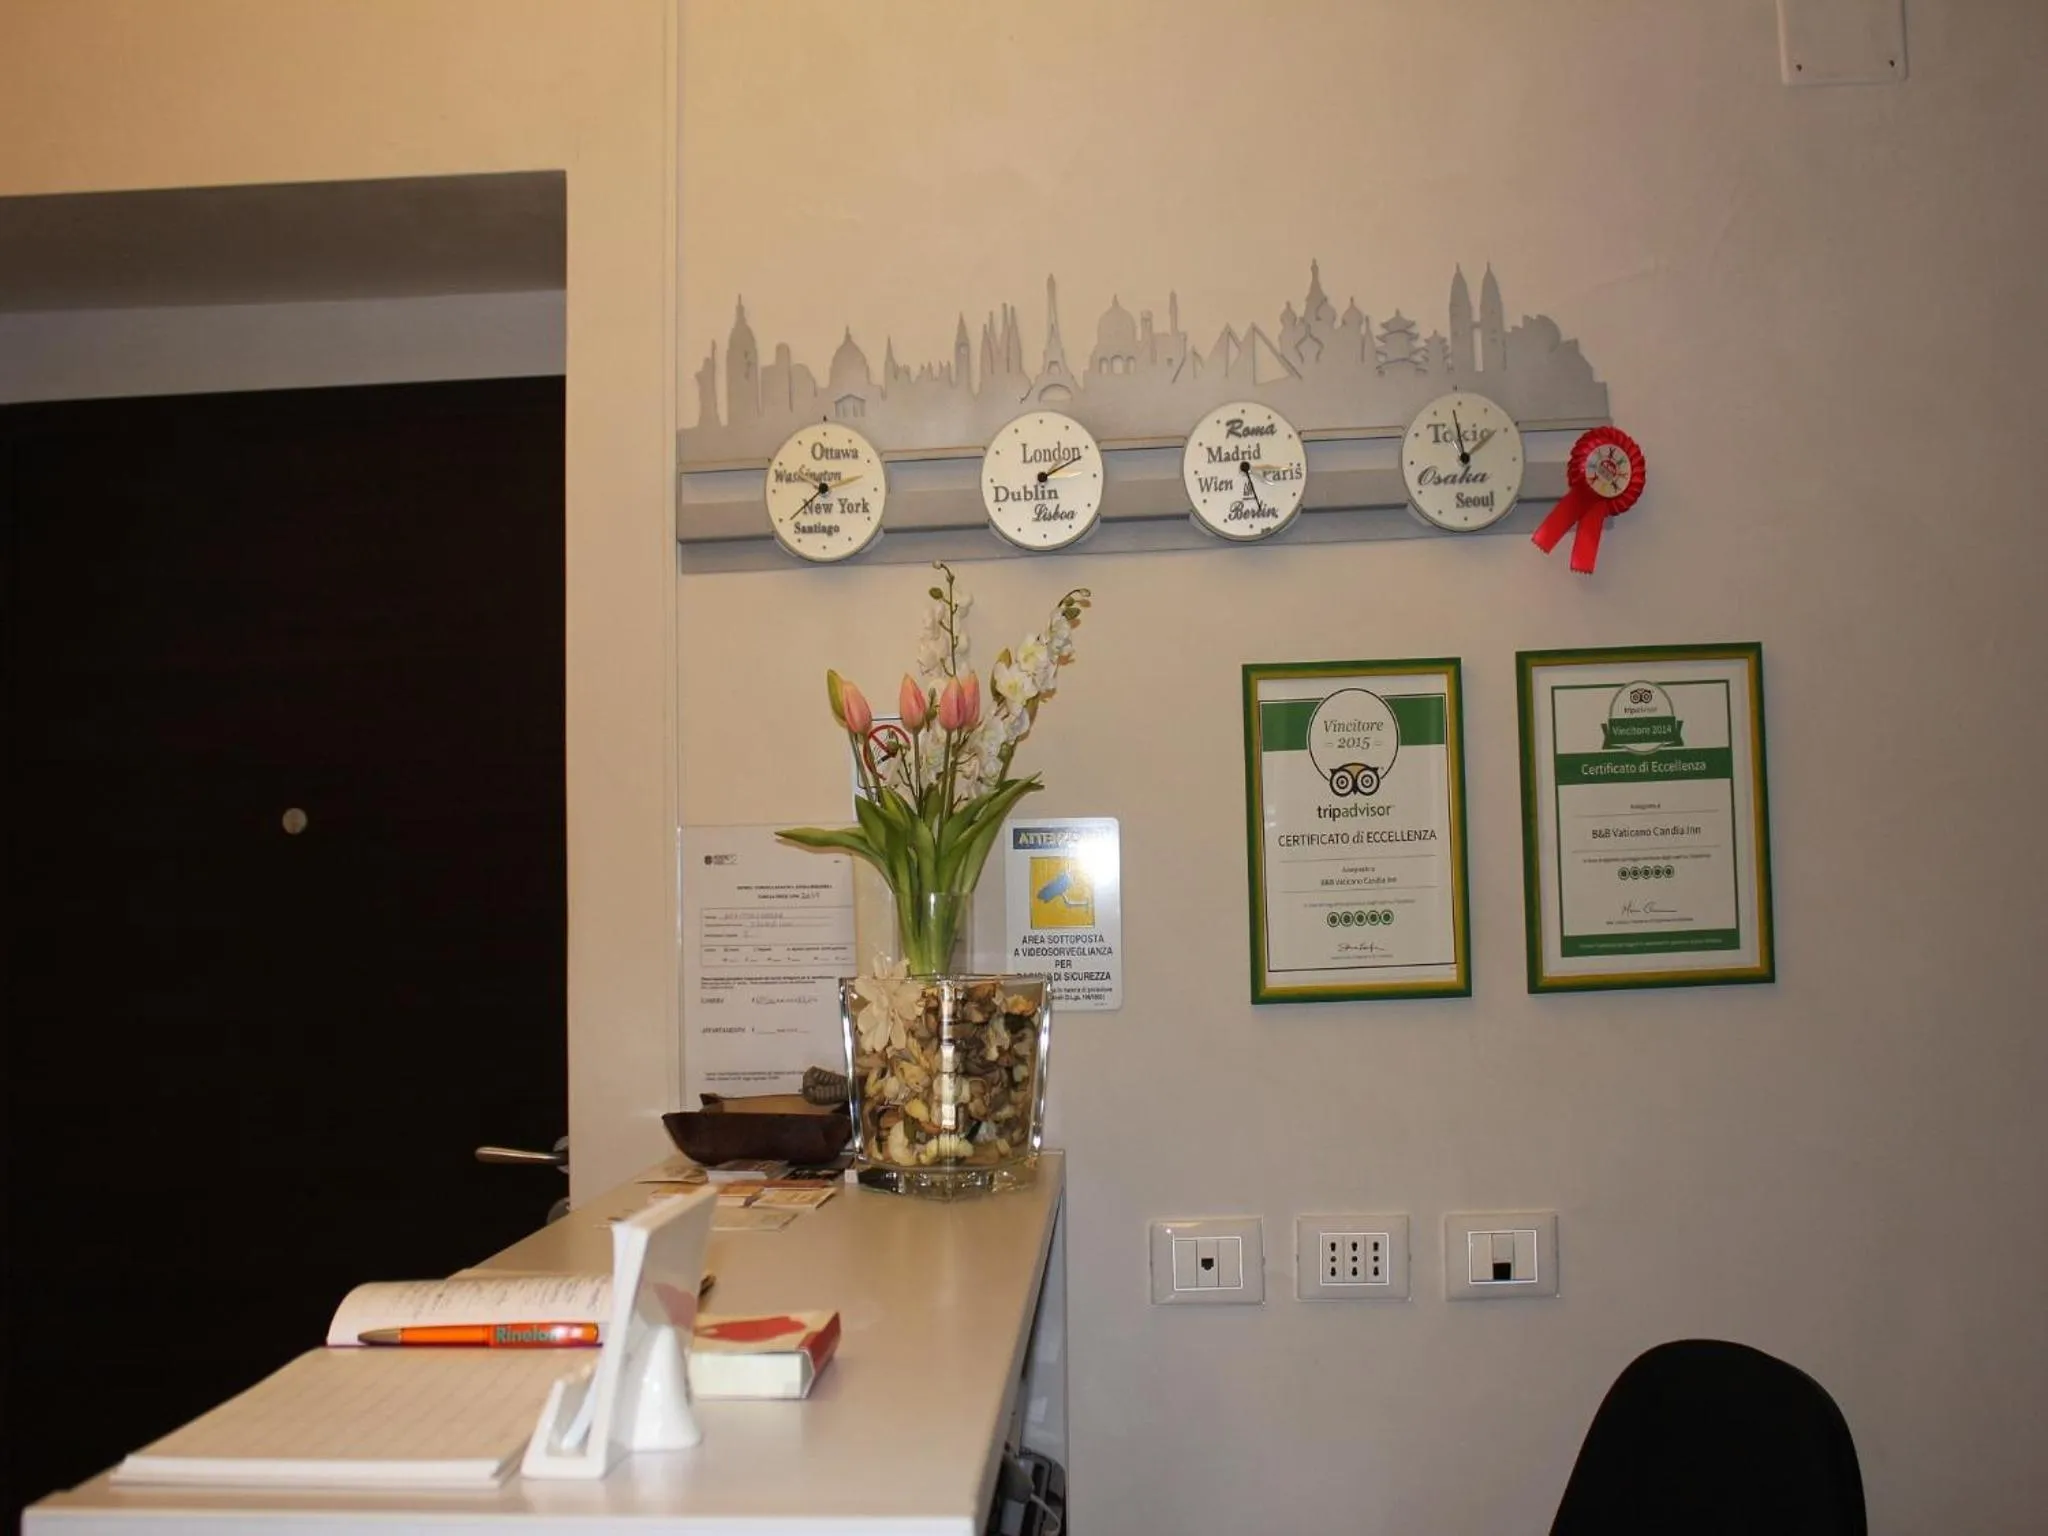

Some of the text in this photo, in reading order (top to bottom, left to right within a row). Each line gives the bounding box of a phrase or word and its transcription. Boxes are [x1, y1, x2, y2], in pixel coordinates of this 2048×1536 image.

[1225, 418, 1277, 439] Roma
[811, 442, 859, 460] Ottawa
[1021, 440, 1081, 464] London
[1206, 443, 1262, 464] Madrid
[774, 467, 842, 484] Washington
[1417, 465, 1488, 486] Osaka
[993, 484, 1059, 502] Dublin
[1198, 476, 1234, 493] Wien
[803, 497, 870, 515] New York
[1456, 490, 1494, 508] Seoul
[1032, 503, 1076, 522] Lisboa
[1228, 500, 1276, 520] Berlin
[794, 521, 840, 536] Santiago
[1323, 719, 1384, 733] Vincitore
[1337, 737, 1371, 750] 2015
[1581, 759, 1706, 776] Certificato di Eccellenza
[1317, 804, 1392, 821] tripadvisor
[1278, 829, 1437, 847] CERTIFICATO di ECCELLENZA
[1592, 825, 1701, 839] B&B Vaticano Candia Inn
[1022, 934, 1104, 945] AREA SOTTOPOSTA
[1014, 946, 1113, 957] A VIDEOSORVEGLIANZA
[1055, 959, 1072, 969] PER
[1064, 971, 1111, 981] SICUREZZA
